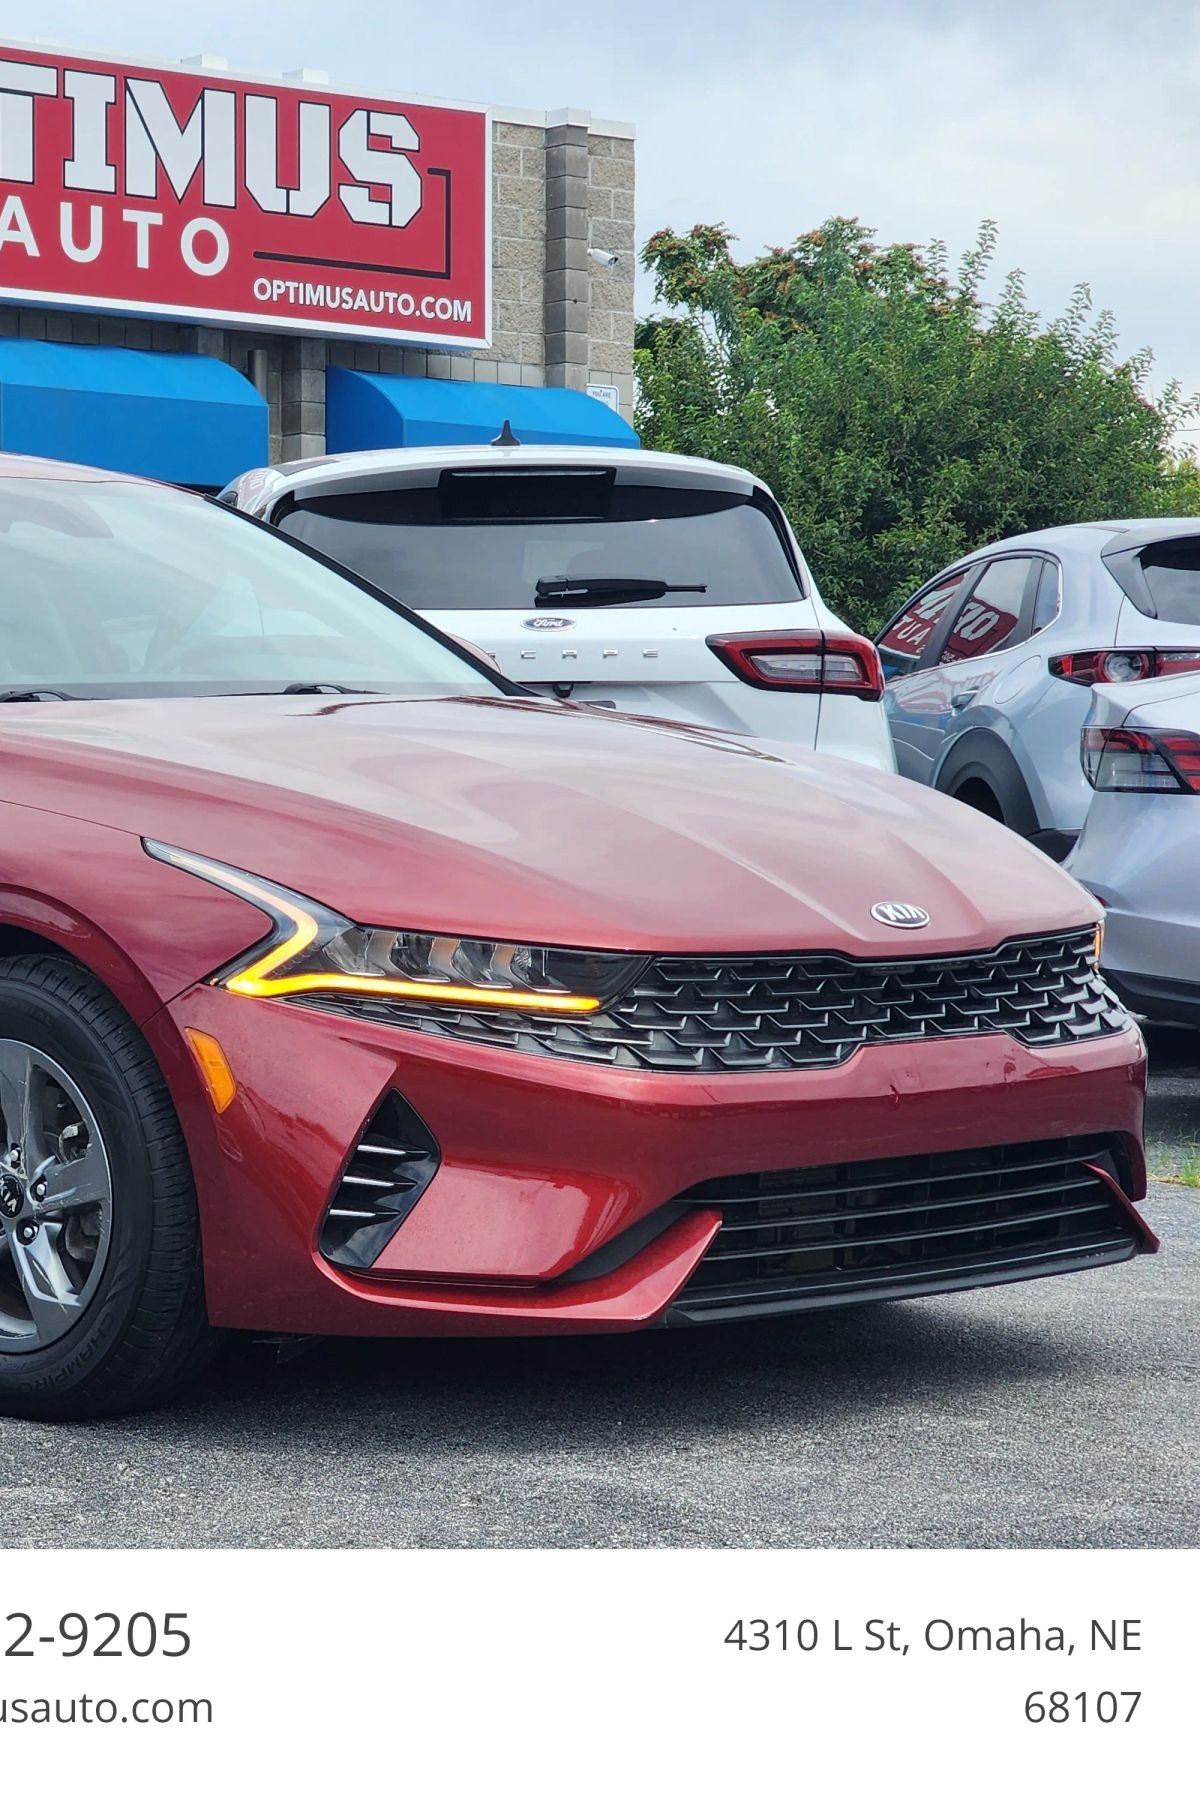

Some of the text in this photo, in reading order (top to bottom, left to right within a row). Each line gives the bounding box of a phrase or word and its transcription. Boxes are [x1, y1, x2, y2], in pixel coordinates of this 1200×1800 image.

[253, 277, 472, 322] OPTIMUSAUTO.COM
[533, 617, 563, 628] Ford
[878, 904, 926, 921] KIA
